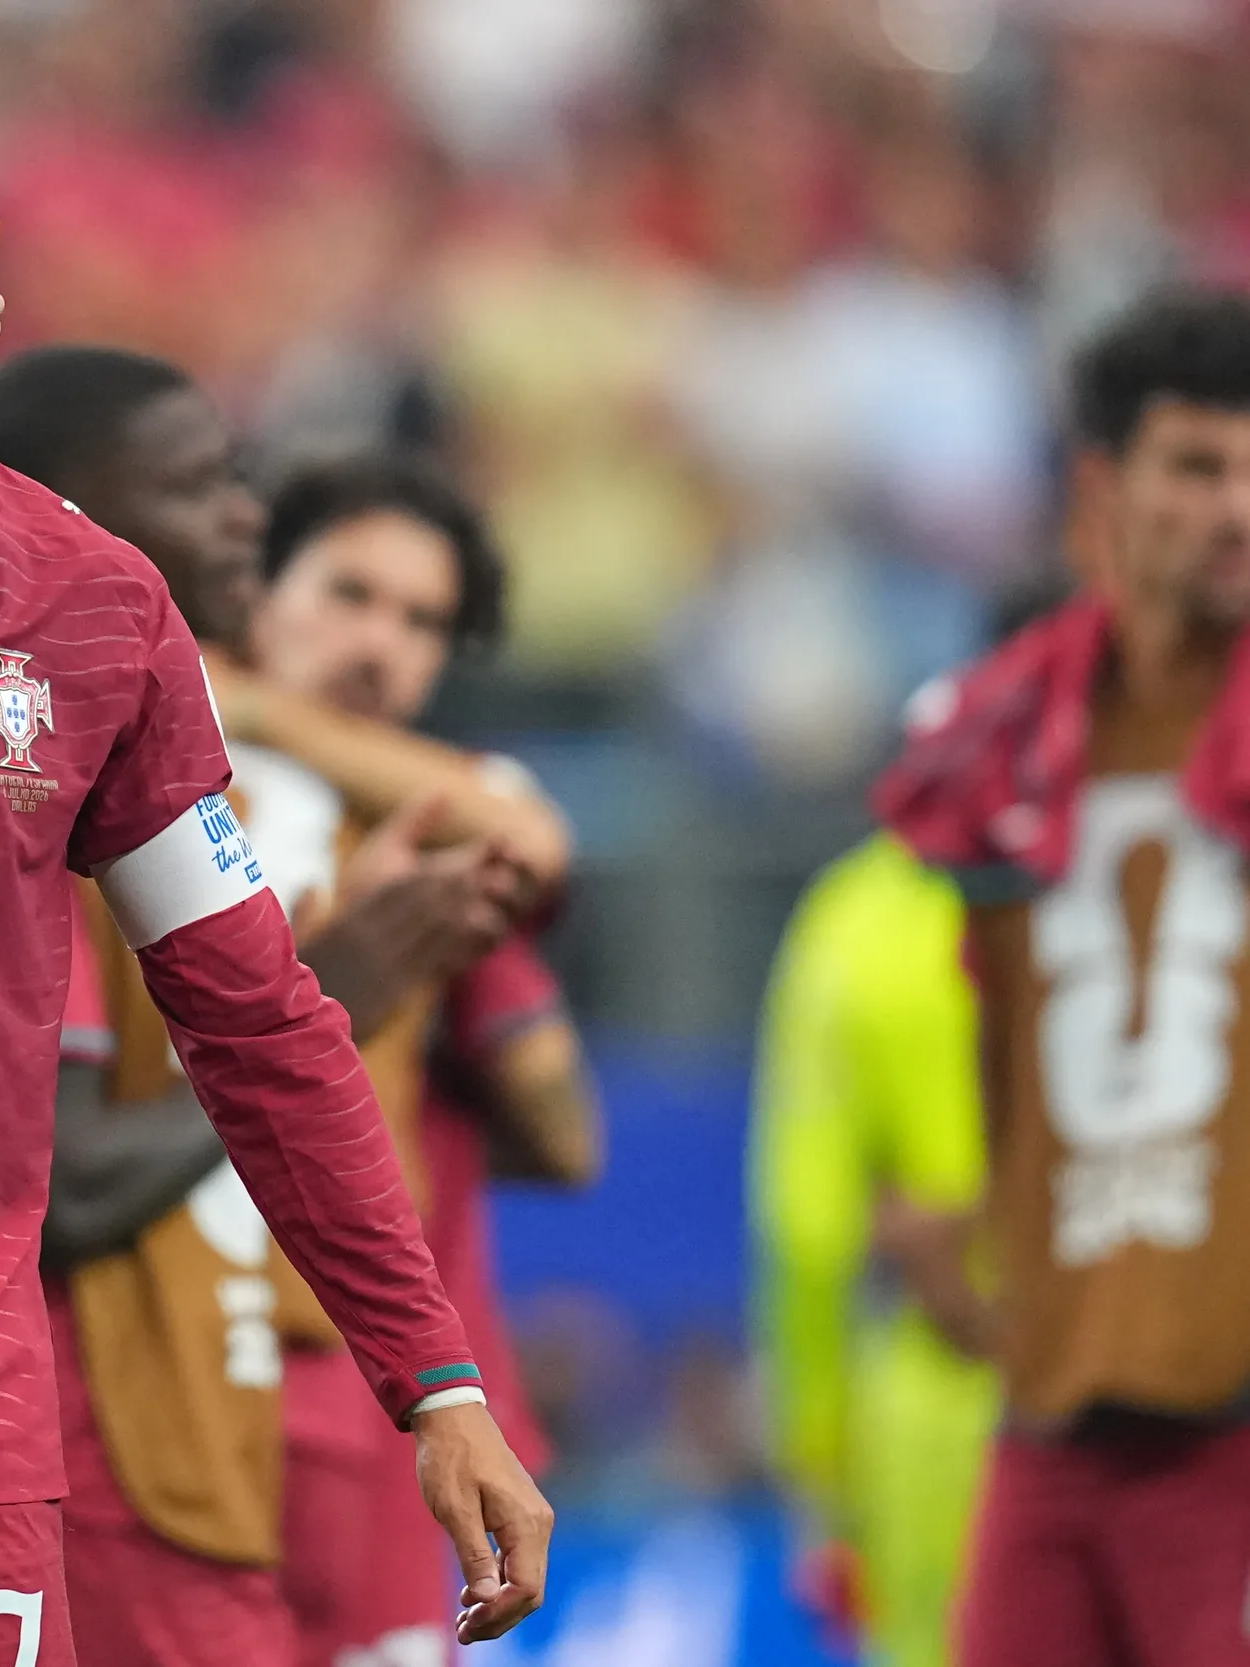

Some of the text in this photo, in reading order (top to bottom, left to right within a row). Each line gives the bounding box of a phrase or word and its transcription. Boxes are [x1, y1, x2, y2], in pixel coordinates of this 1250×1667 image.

[30, 789, 49, 802] 2026
[11, 800, 37, 812] DALLAS
[211, 845, 241, 873] the
